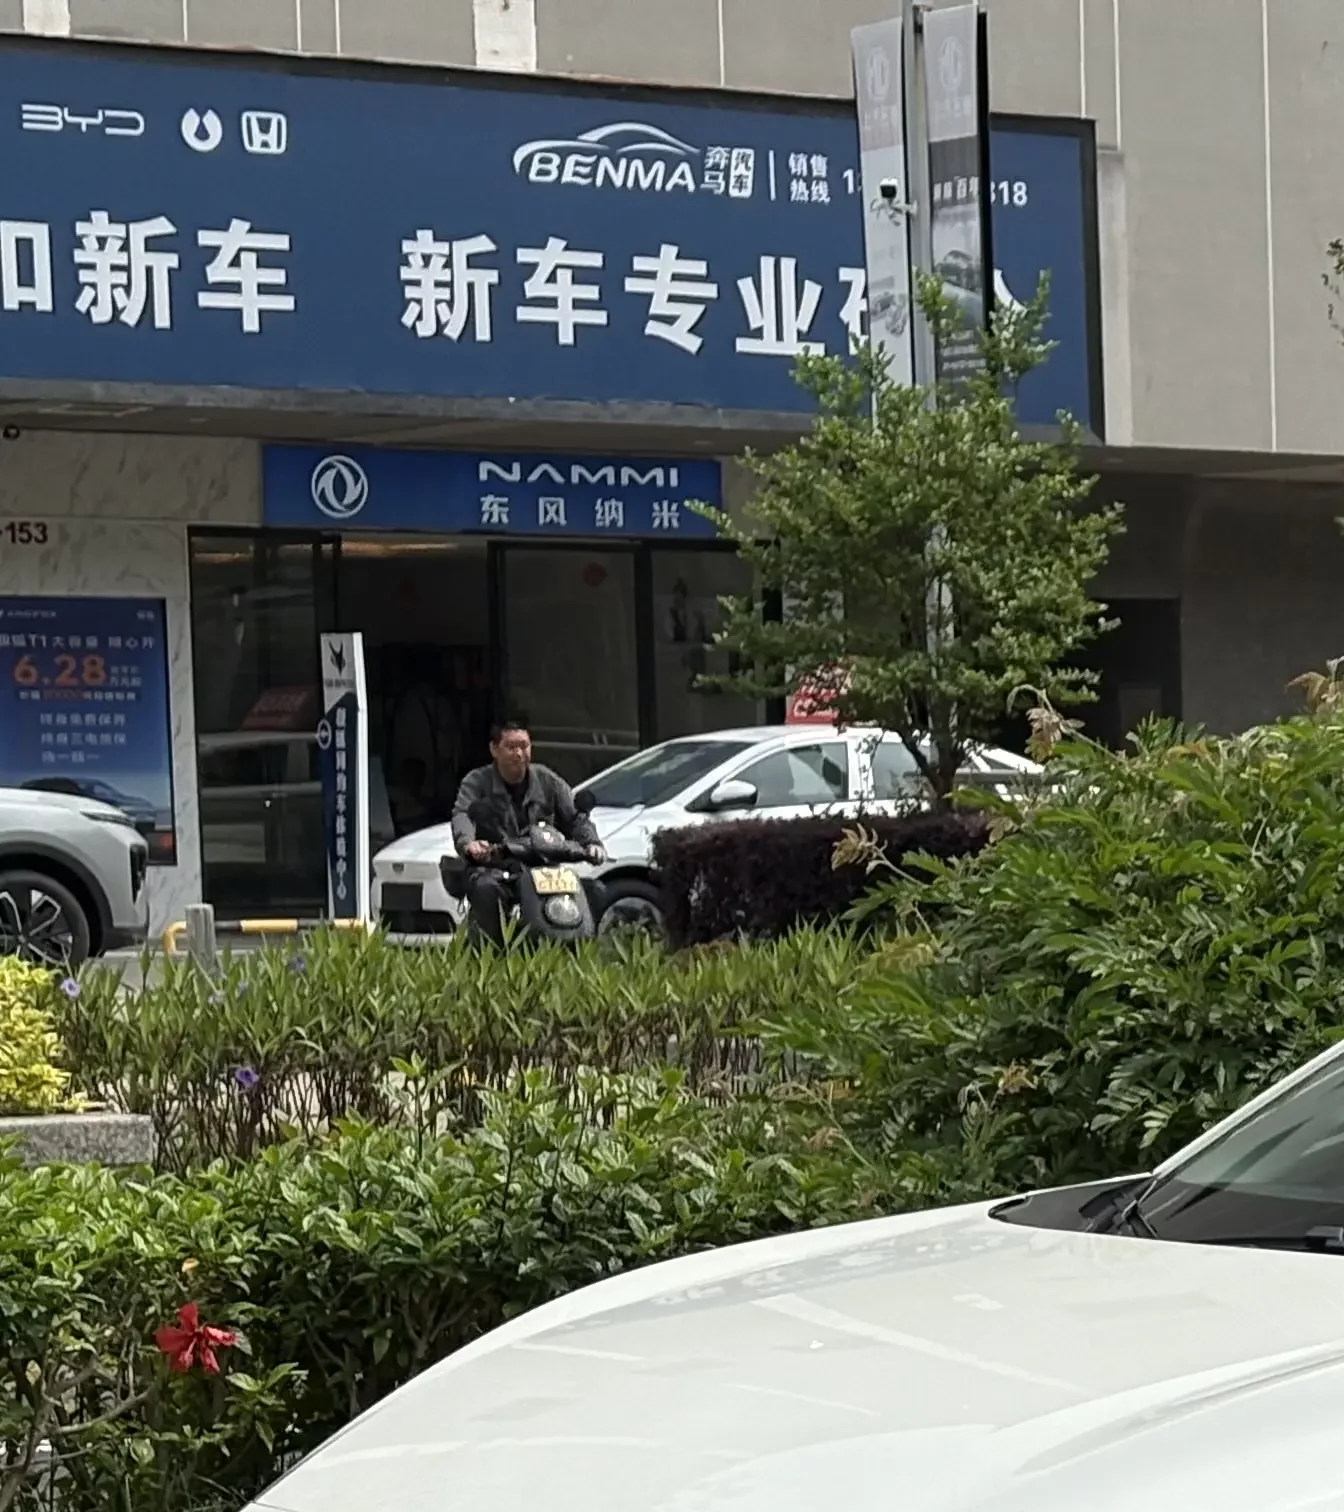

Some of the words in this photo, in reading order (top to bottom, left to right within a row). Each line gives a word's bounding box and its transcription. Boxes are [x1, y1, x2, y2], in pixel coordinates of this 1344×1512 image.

[21, 103, 145, 137] BYD
[527, 151, 695, 193] BENMA
[700, 146, 730, 195] 奔马
[731, 151, 752, 193] 汽车
[788, 152, 828, 178] 销售
[790, 178, 831, 206] 热线
[399, 228, 1029, 357] 新车专业
[478, 460, 680, 488] NAMMI
[480, 494, 681, 529] 东风纳米
[14, 654, 107, 686] 6.28
